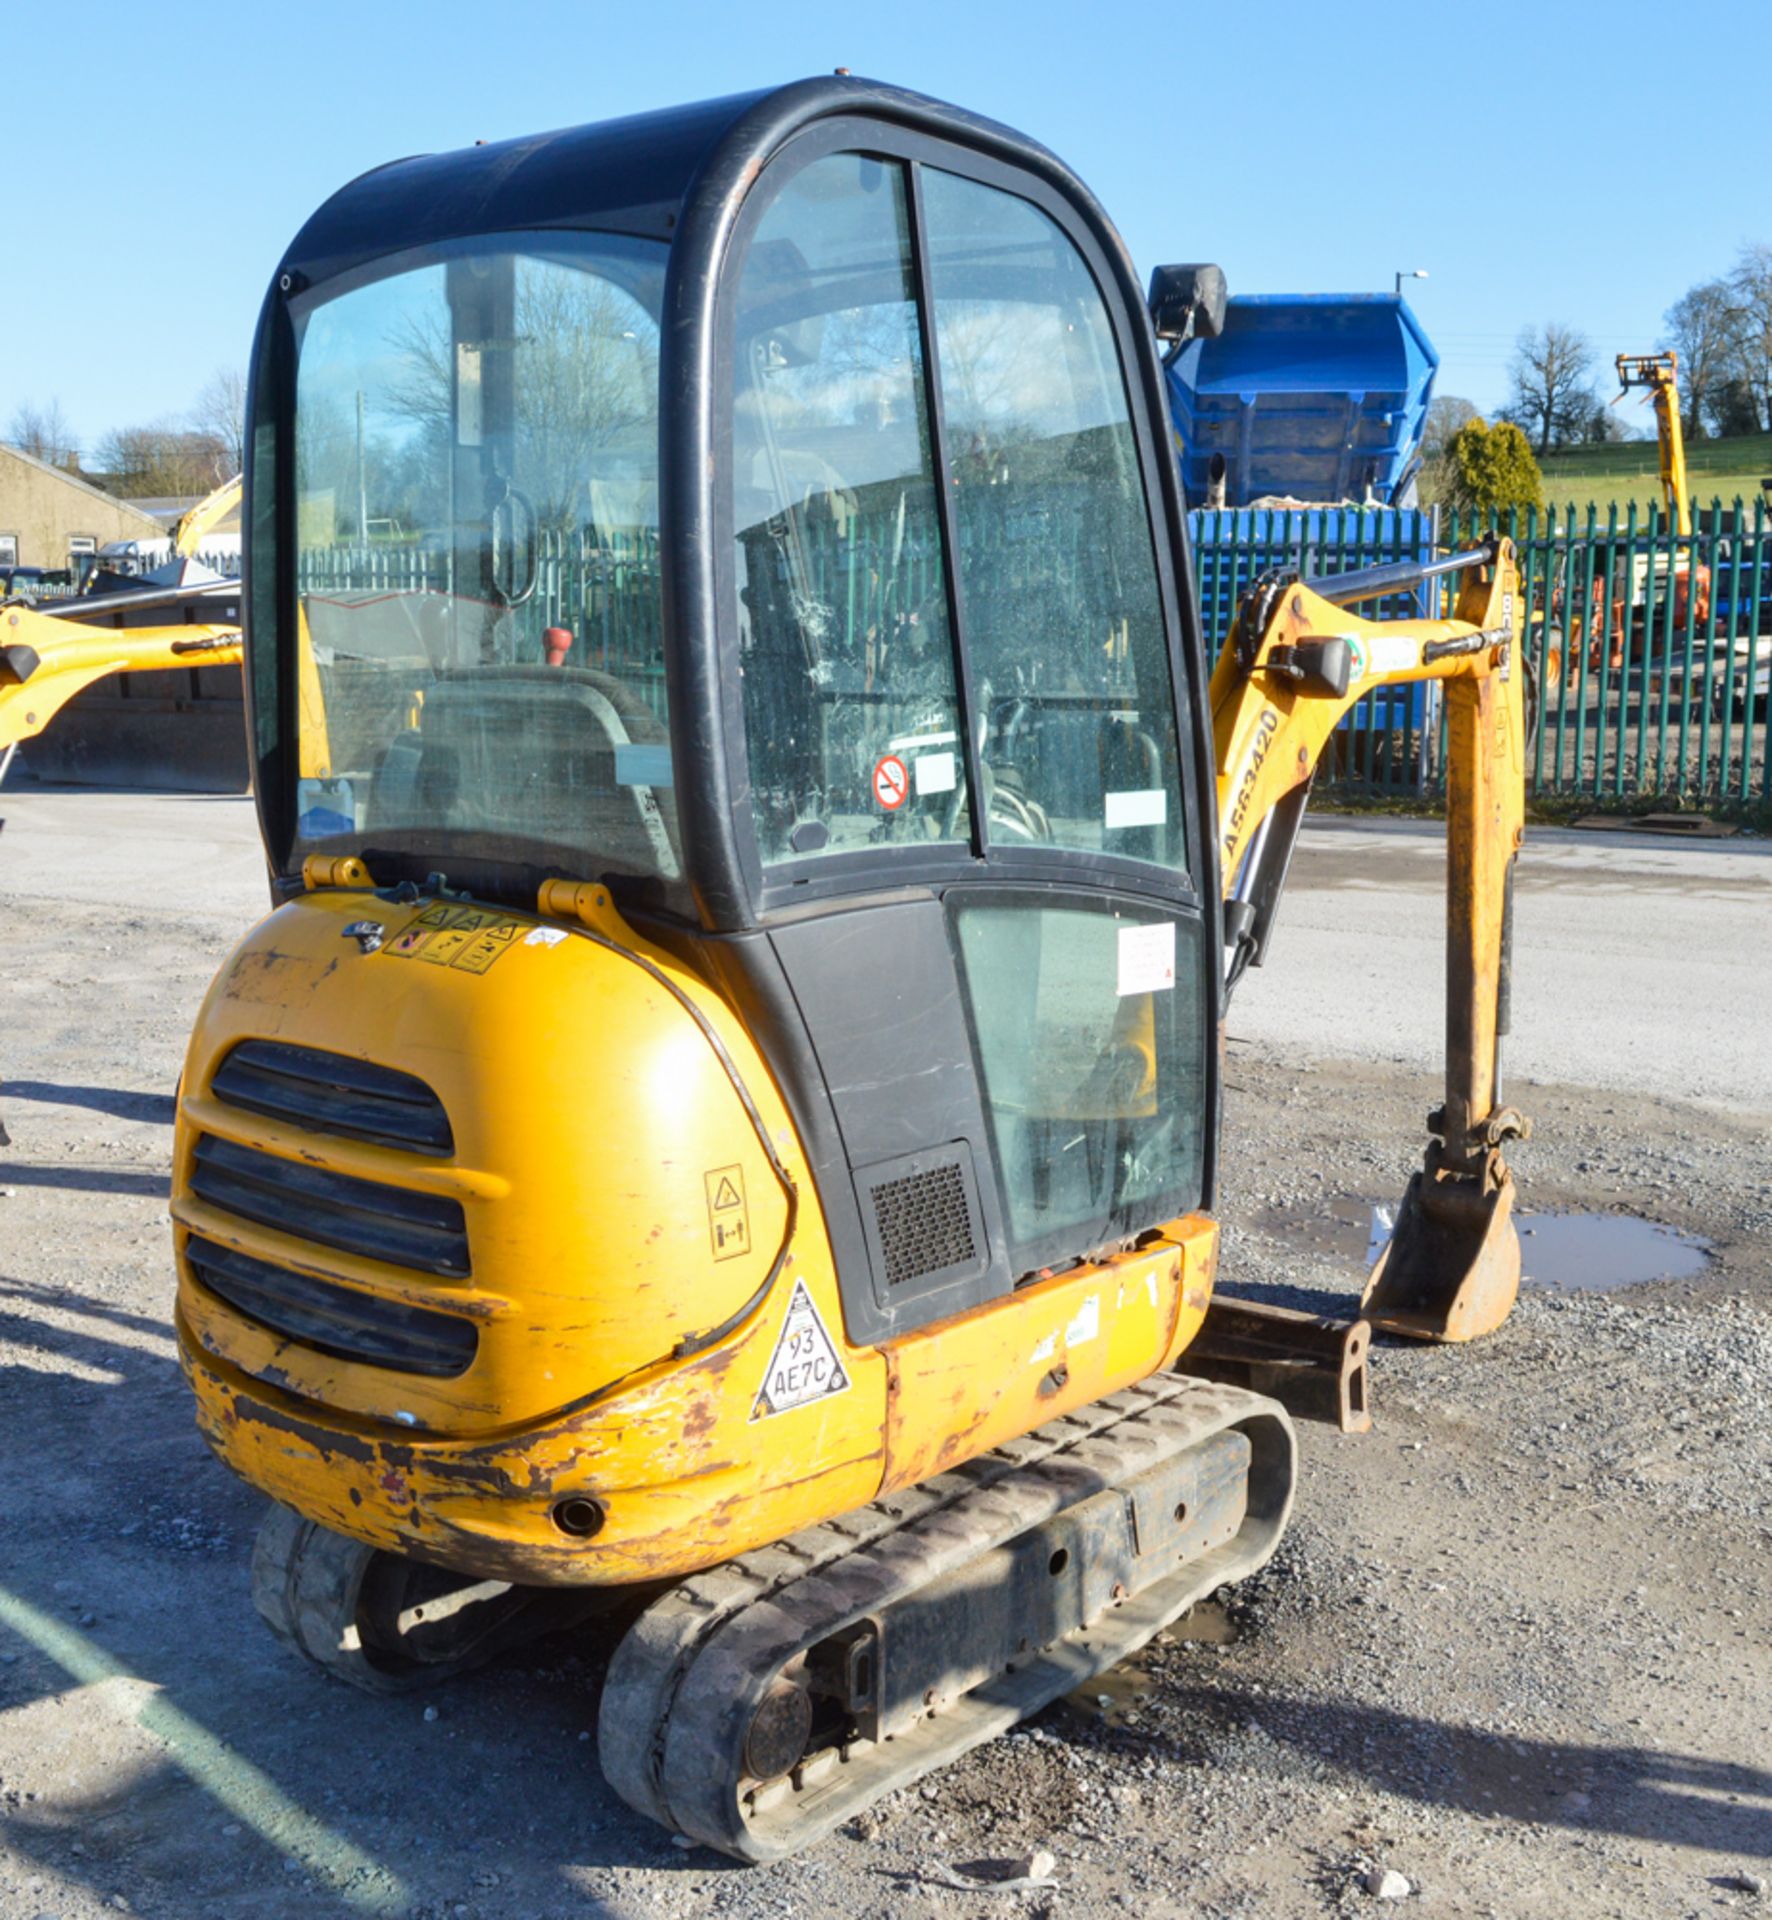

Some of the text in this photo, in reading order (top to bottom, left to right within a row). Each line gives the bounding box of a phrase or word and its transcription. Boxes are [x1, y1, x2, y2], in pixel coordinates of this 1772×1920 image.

[1224, 710, 1279, 858] A563420
[788, 1328, 816, 1360] 93
[773, 1356, 827, 1395] AE7C
